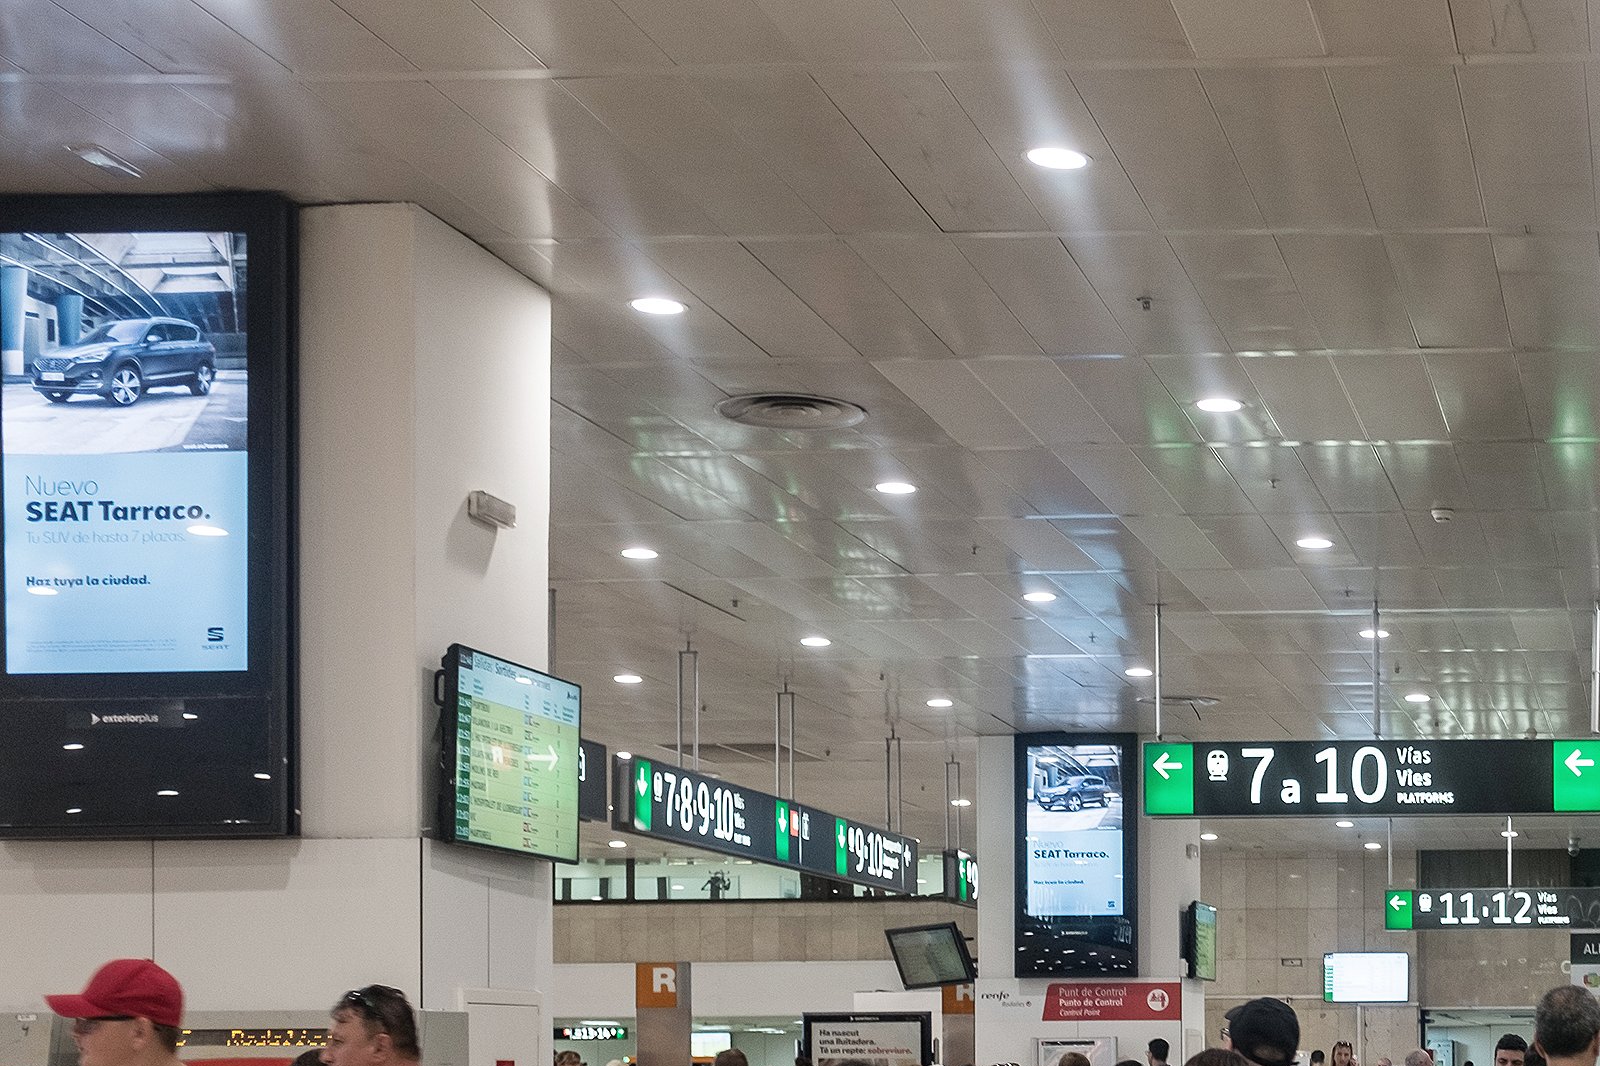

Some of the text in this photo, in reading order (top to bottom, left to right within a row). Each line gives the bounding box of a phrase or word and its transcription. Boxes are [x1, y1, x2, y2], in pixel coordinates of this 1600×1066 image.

[25, 475, 98, 497] Nuevo
[26, 500, 211, 522] SEAT Tarraco.
[26, 531, 39, 544] Tu
[43, 531, 69, 544] SUV
[72, 531, 89, 543] de
[93, 530, 129, 543] hasta
[131, 531, 139, 543] 7
[27, 574, 150, 588] Haz tuya la ciudad.
[102, 713, 158, 724] exteriorplus
[1396, 745, 1432, 765] Vías
[1241, 746, 1388, 804] 7 a 10
[1395, 768, 1432, 787] Vies
[1396, 791, 1455, 805] PLATFORMS
[1034, 849, 1110, 859] SEAT Tarraco.
[652, 967, 676, 993] R
[981, 991, 1009, 1001] renfe
[1059, 986, 1127, 997] Punt de Control
[1059, 998, 1123, 1007] Punto de Control
